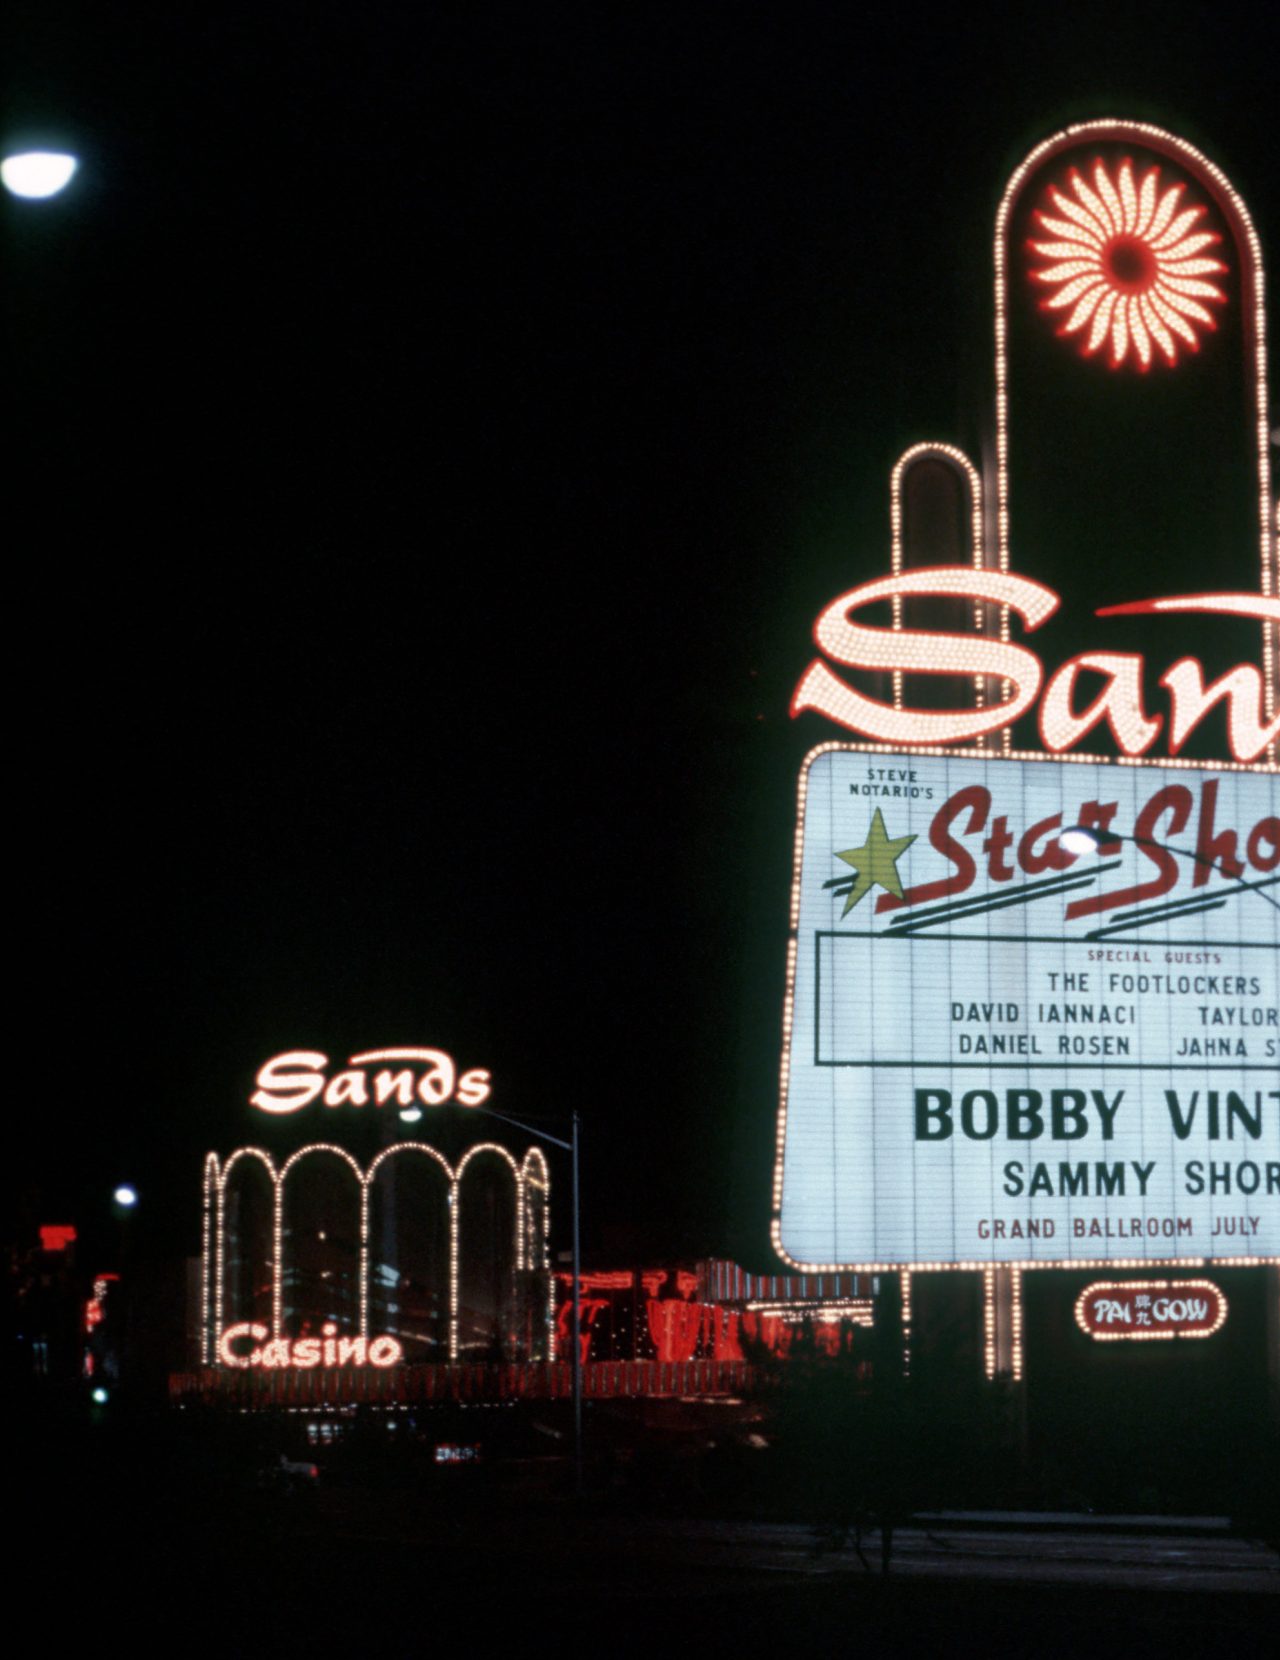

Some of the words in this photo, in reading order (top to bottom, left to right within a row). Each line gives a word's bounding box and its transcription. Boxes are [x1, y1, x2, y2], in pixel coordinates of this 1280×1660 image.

[867, 768, 918, 783] STEVE
[849, 783, 934, 800] NOTARIO'S
[1087, 949, 1151, 964] SPECIAL
[1165, 952, 1223, 966] GUESTS
[1047, 972, 1090, 993] THE
[1109, 973, 1262, 996] FOOTLOCKERS
[951, 1002, 1019, 1024] DAVID
[1038, 1004, 1136, 1025] IANNACI
[1197, 1006, 1280, 1027] TAYLOR
[958, 1034, 1042, 1056] DANIEL
[1057, 1036, 1131, 1056] ROSEN
[1176, 1037, 1248, 1057] JAHNA
[249, 1047, 491, 1114] Sands
[914, 1088, 1126, 1141] BOBBY
[1002, 1160, 1157, 1198] SAMMY
[977, 1216, 1056, 1240] GRAND
[1072, 1217, 1193, 1239] BALLROOM
[1210, 1215, 1261, 1236] JULY
[1094, 1299, 1132, 1324] PAI
[1152, 1297, 1208, 1322] GOW
[219, 1323, 403, 1369] Casino
